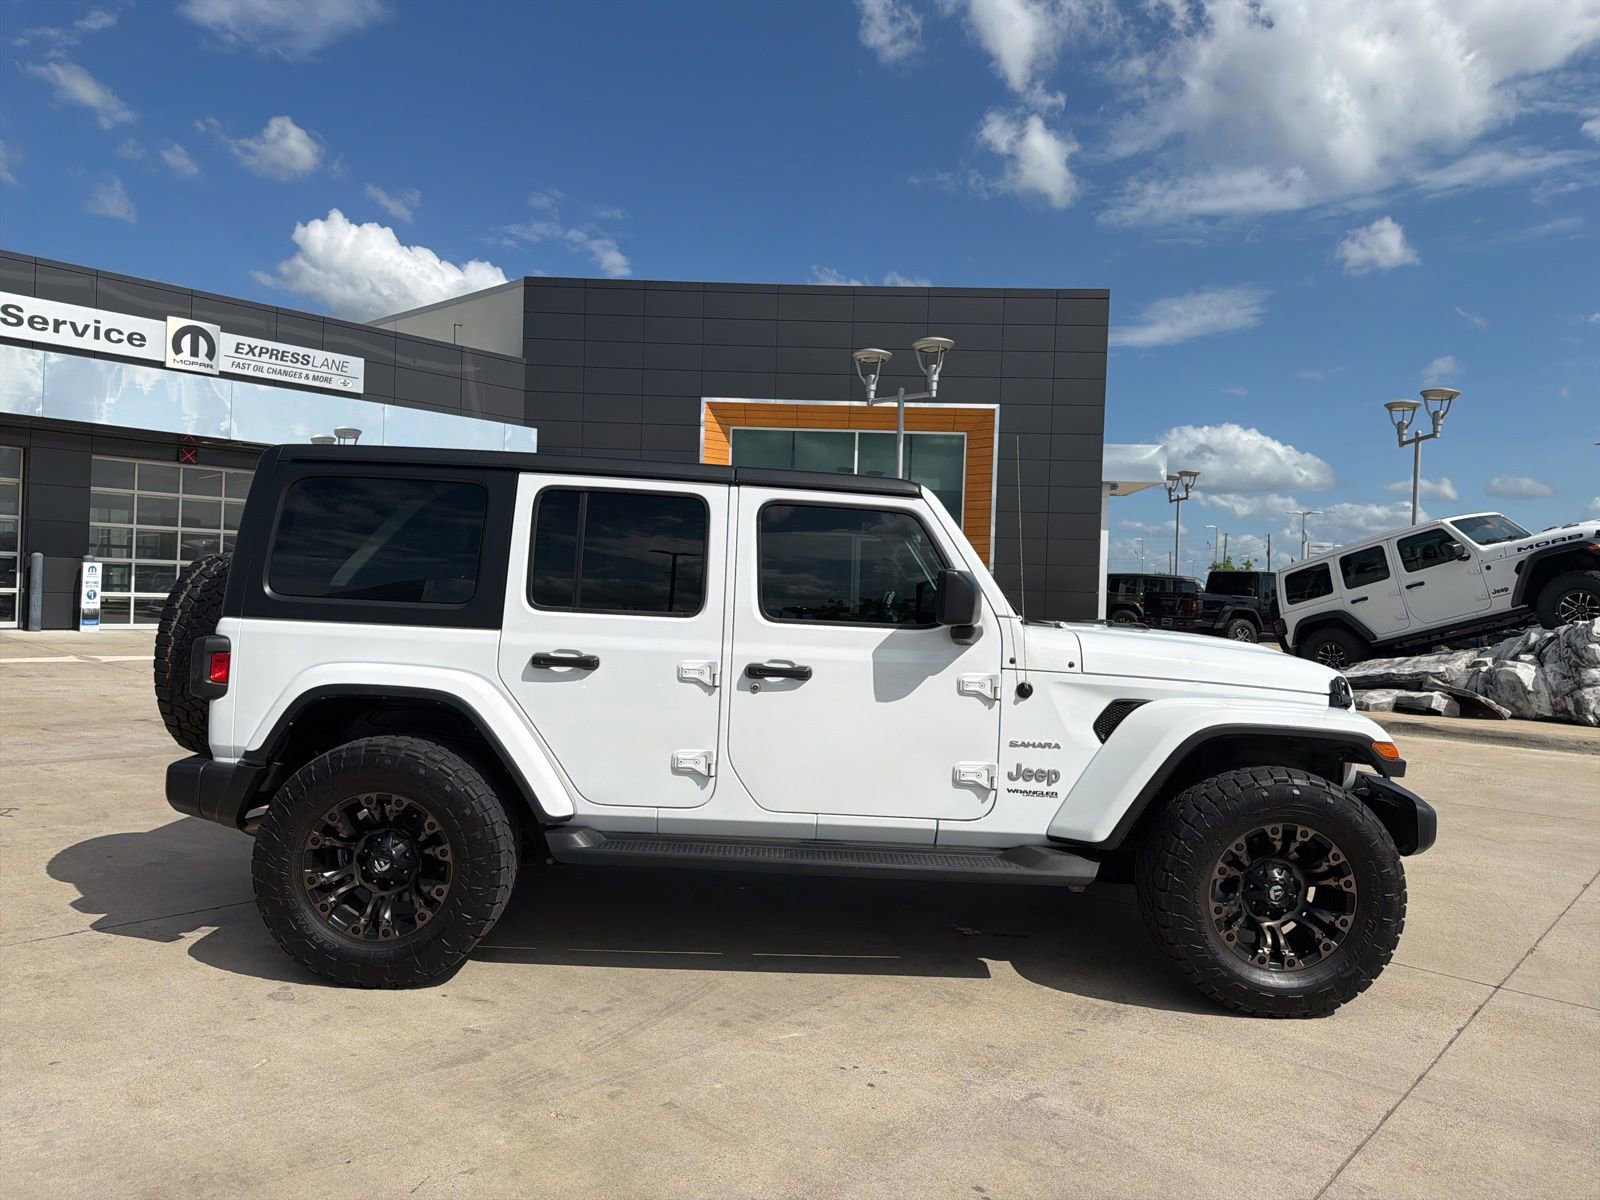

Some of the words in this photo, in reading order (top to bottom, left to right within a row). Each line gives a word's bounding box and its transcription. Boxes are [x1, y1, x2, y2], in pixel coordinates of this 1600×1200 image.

[0, 303, 147, 348] Service
[173, 358, 214, 370] MOPAR
[231, 360, 252, 371] FAST
[252, 364, 265, 374] OIL
[266, 366, 303, 380] CHANGES
[303, 373, 310, 381] &
[311, 374, 334, 385] MORE
[1491, 586, 1509, 595] Jeep
[1008, 740, 1062, 750] SAHARA
[1007, 762, 1061, 787] Jeep
[1007, 788, 1058, 796] WRANGLER
